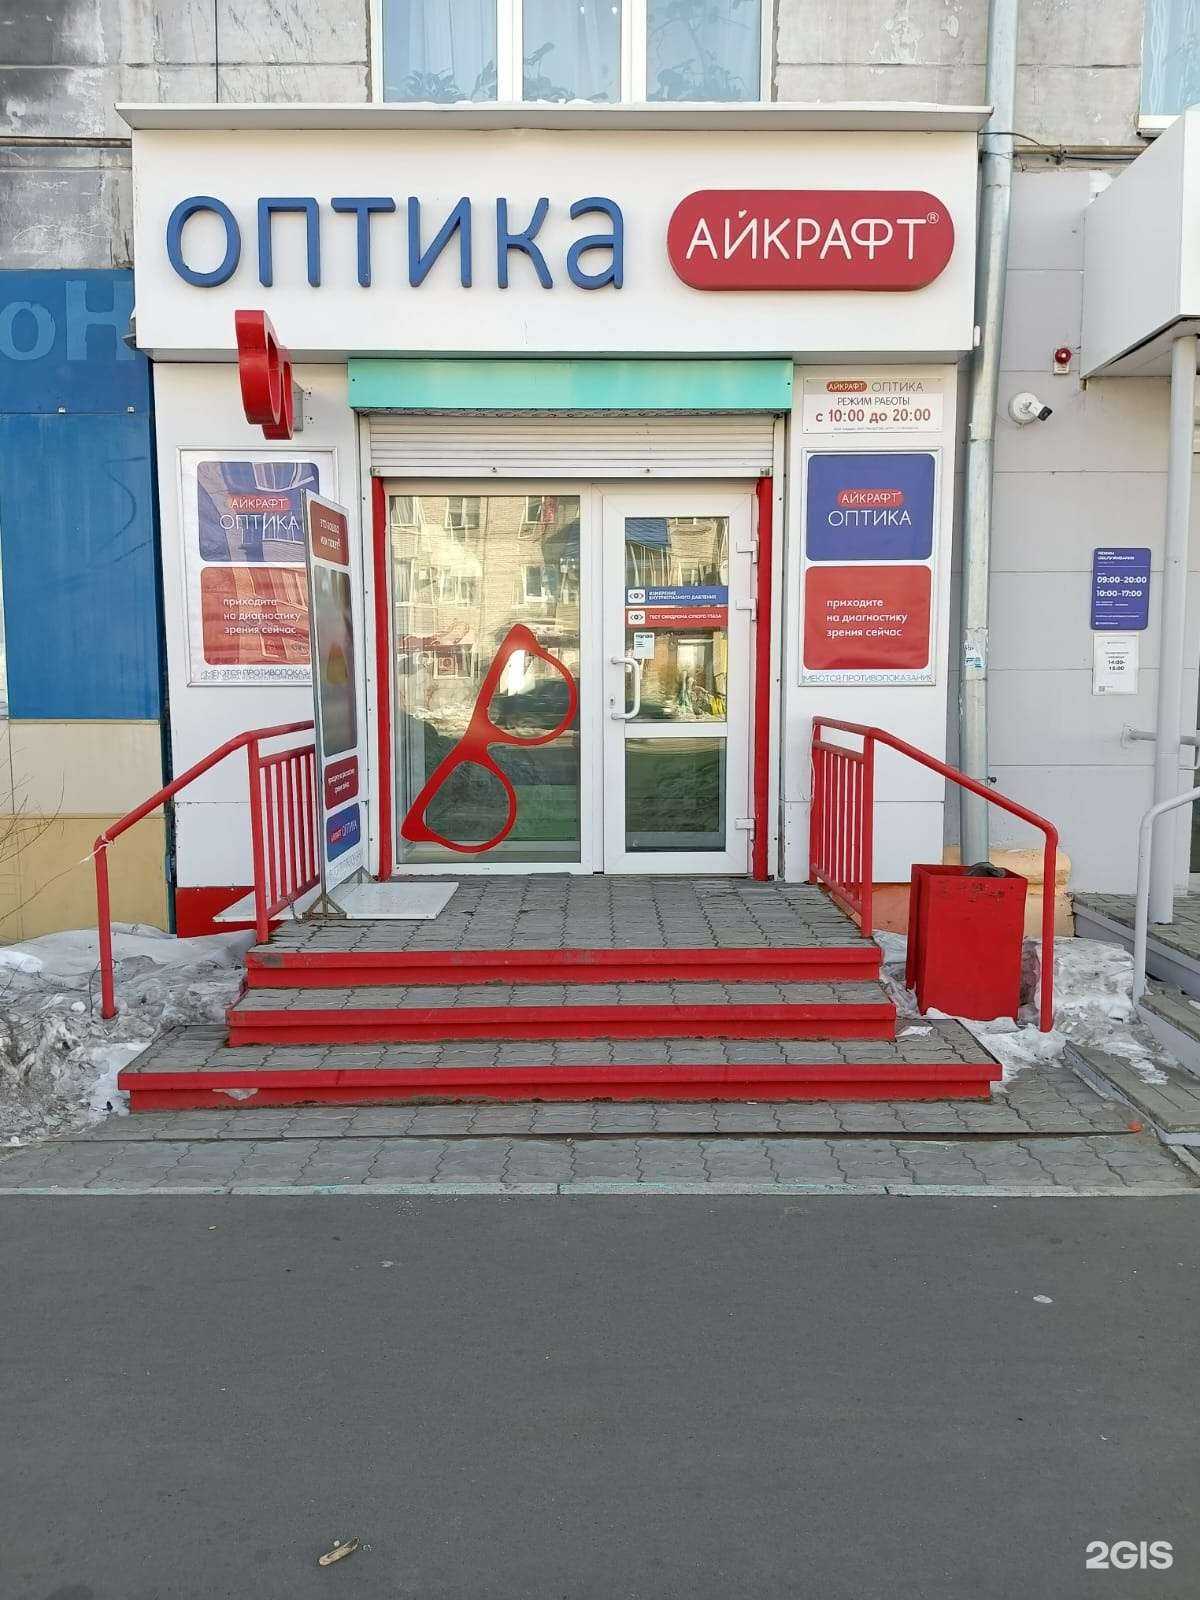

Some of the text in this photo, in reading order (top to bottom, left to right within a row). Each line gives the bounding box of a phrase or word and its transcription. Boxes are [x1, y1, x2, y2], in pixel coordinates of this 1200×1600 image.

[871, 382, 924, 392] ОПТИКА
[837, 397, 910, 406] РЕЖИМ РАБОТЫ
[828, 409, 864, 422] 10:00
[869, 412, 888, 424] до
[892, 408, 931, 421] 20:00
[231, 496, 288, 509] АЙКРАФТ
[841, 491, 901, 504] АЙКРАФТ
[219, 514, 300, 530] ОПТИКА
[828, 510, 912, 527] ОПТИКА
[223, 599, 277, 607] приходите
[826, 599, 884, 608] приходите
[238, 614, 301, 622] диагностику
[841, 614, 908, 624] диагностику
[826, 627, 903, 638] зрения сейчас
